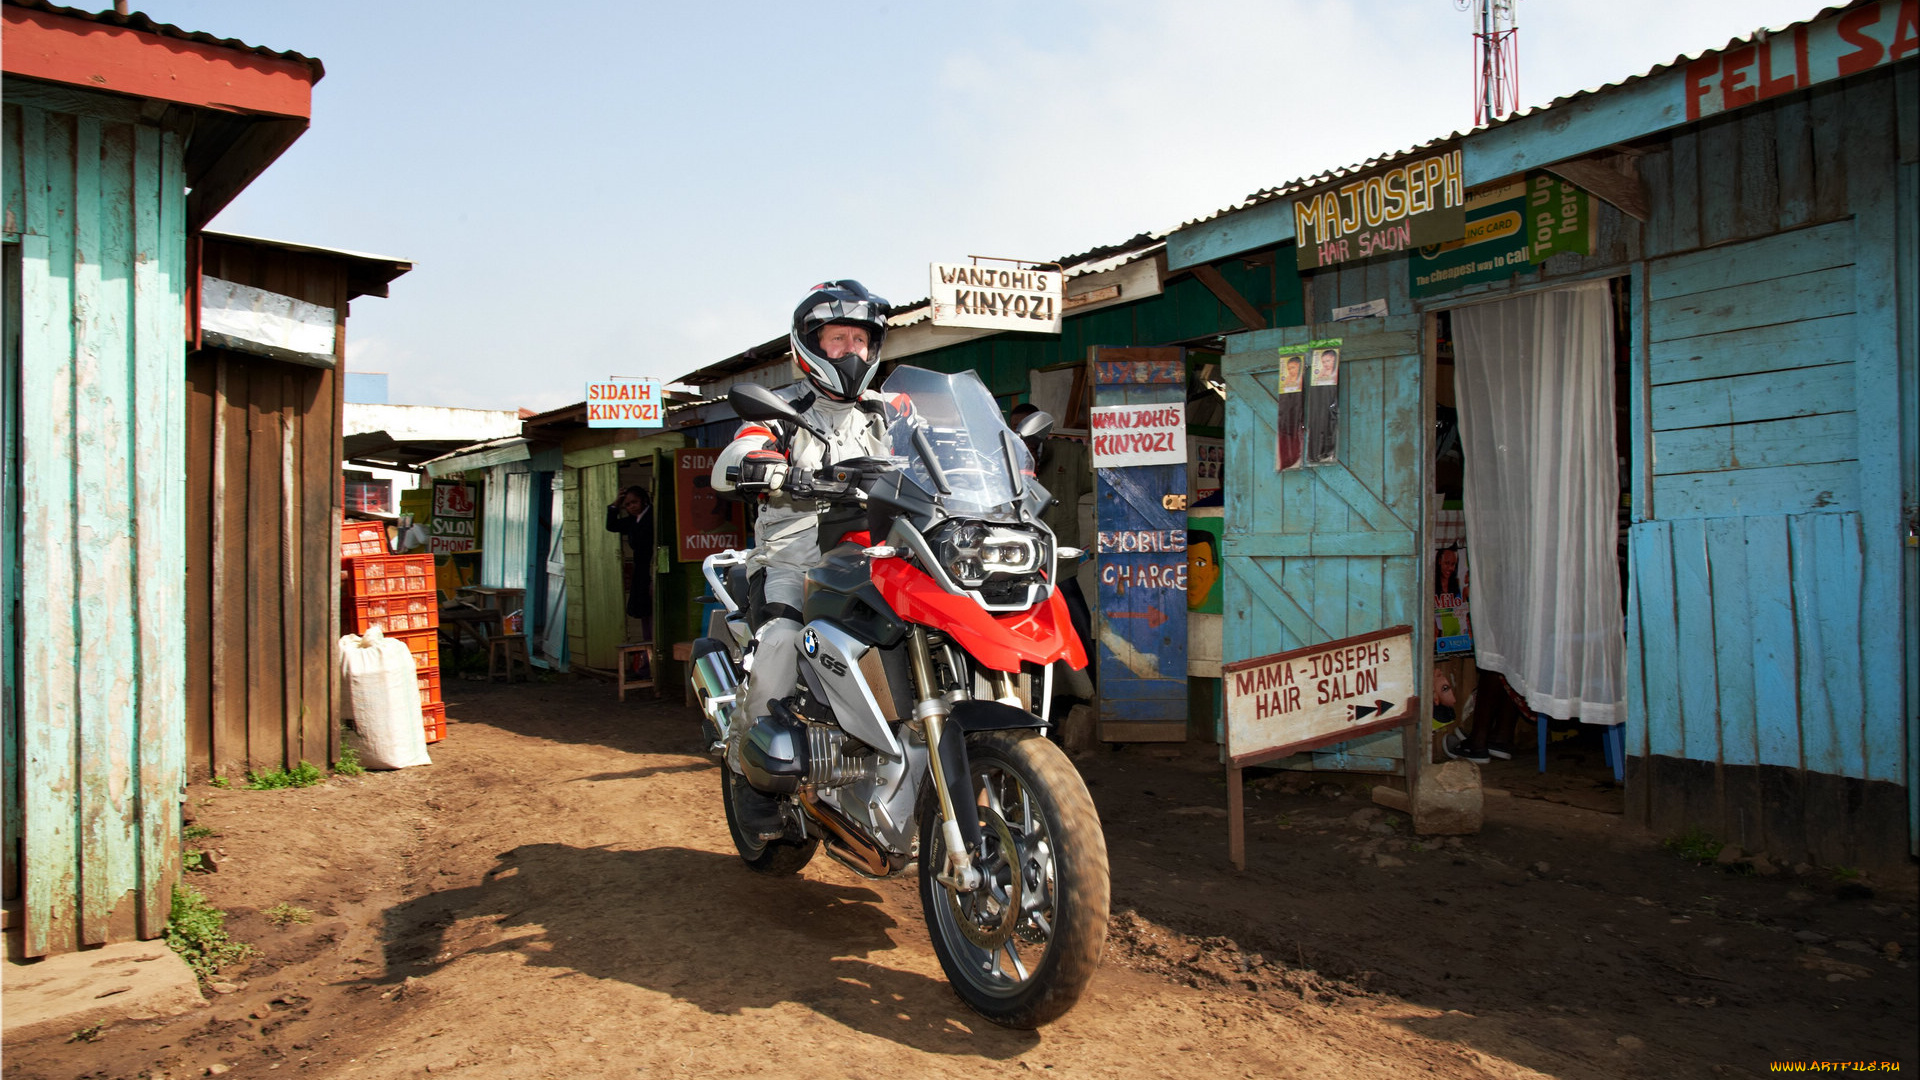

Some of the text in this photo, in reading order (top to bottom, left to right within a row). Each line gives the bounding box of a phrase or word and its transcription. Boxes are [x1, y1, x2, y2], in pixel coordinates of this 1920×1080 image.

[1686, 26, 1811, 121] FELI
[1295, 149, 1464, 248] MAJOSEPH
[1558, 181, 1578, 235] here
[1486, 218, 1513, 234] CARD
[1532, 174, 1556, 256] Top Up
[1358, 218, 1412, 258] SALON
[939, 265, 1048, 291] WANJOHI'S
[1416, 246, 1530, 287] The cheapest way to call
[955, 289, 1054, 321] KINYOZI
[589, 384, 651, 400] SIDAIH
[588, 404, 659, 420] KINYOZI
[1093, 432, 1176, 456] KINYOZI
[432, 518, 476, 536] SALON
[686, 534, 738, 549] KINYOZI
[1097, 530, 1186, 553] MOBILE
[1102, 562, 1187, 590] CHARGE
[820, 653, 848, 677] GS
[1255, 668, 1378, 720] HAIR SALON
